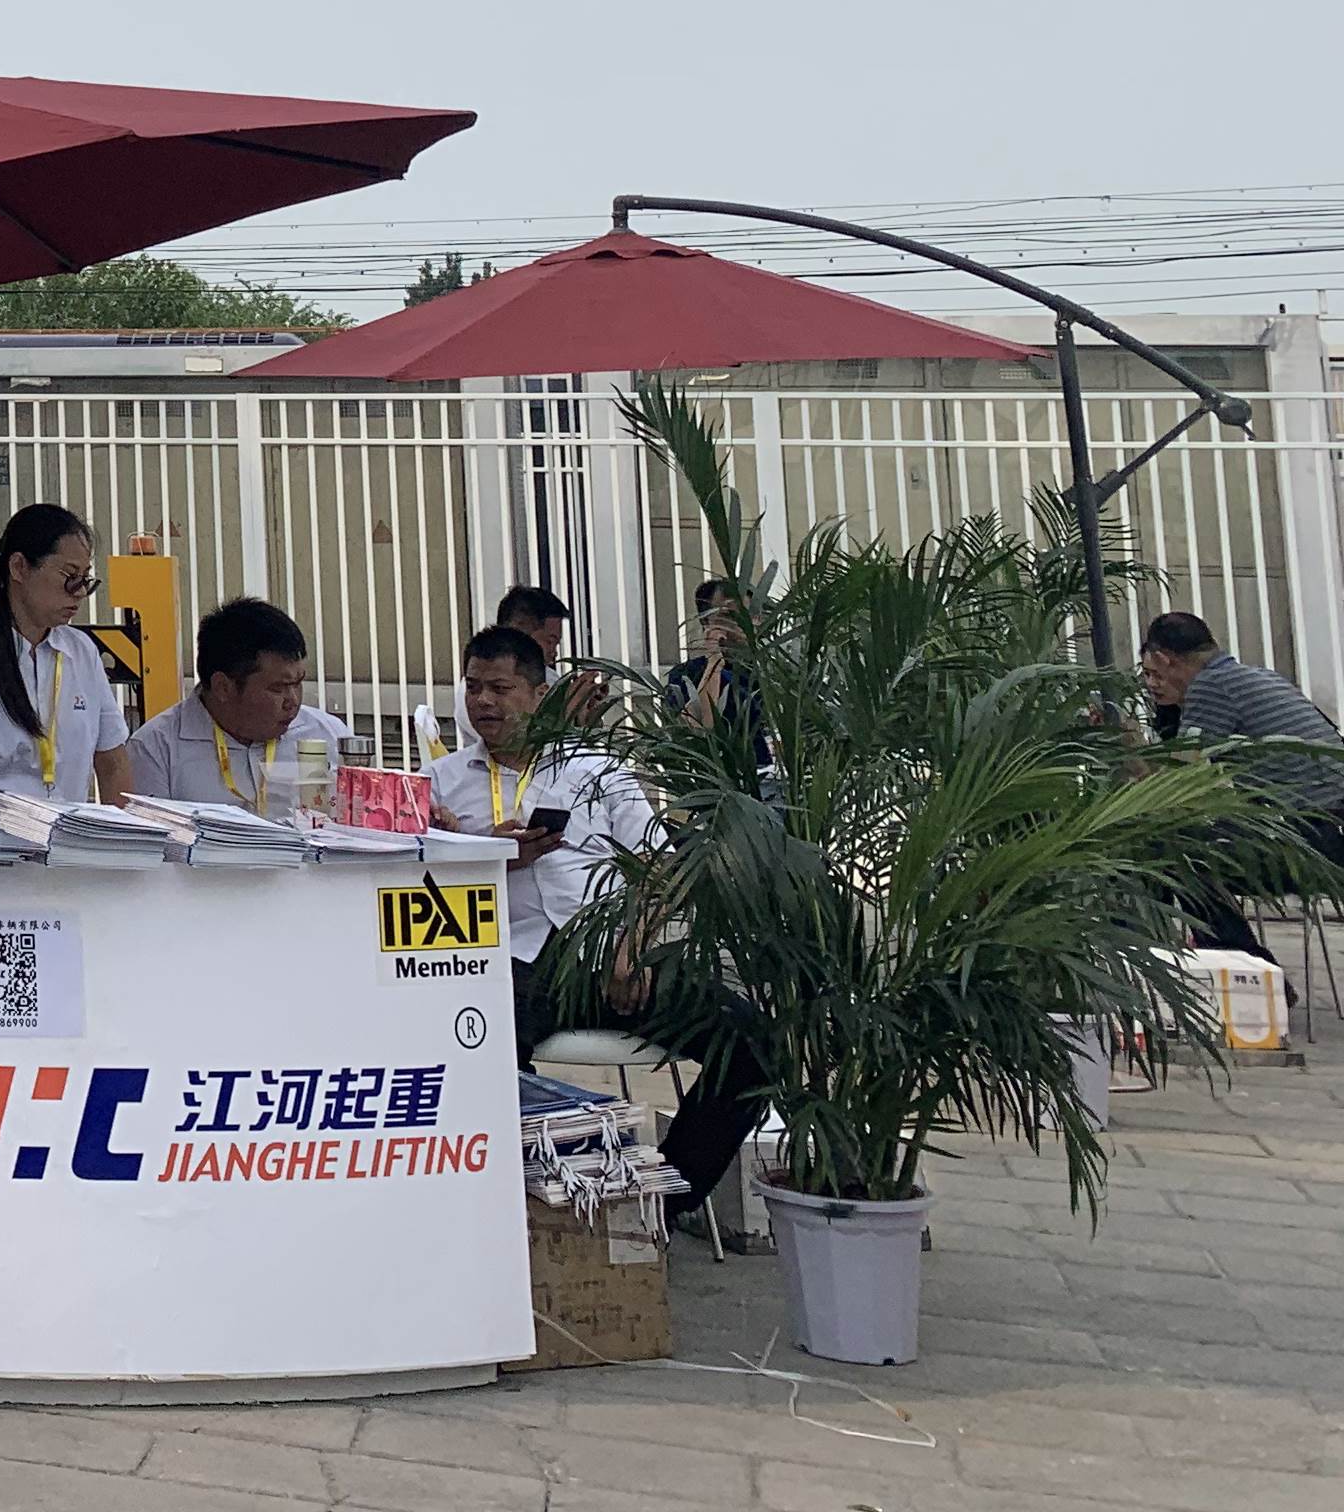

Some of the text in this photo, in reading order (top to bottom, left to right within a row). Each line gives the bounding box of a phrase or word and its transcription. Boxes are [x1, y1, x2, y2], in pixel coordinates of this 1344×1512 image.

[382, 869, 494, 947] IPAF
[395, 954, 489, 978] Member
[175, 1064, 447, 1132] 江河起重
[157, 1132, 489, 1183] JIANGHE LIFTING
